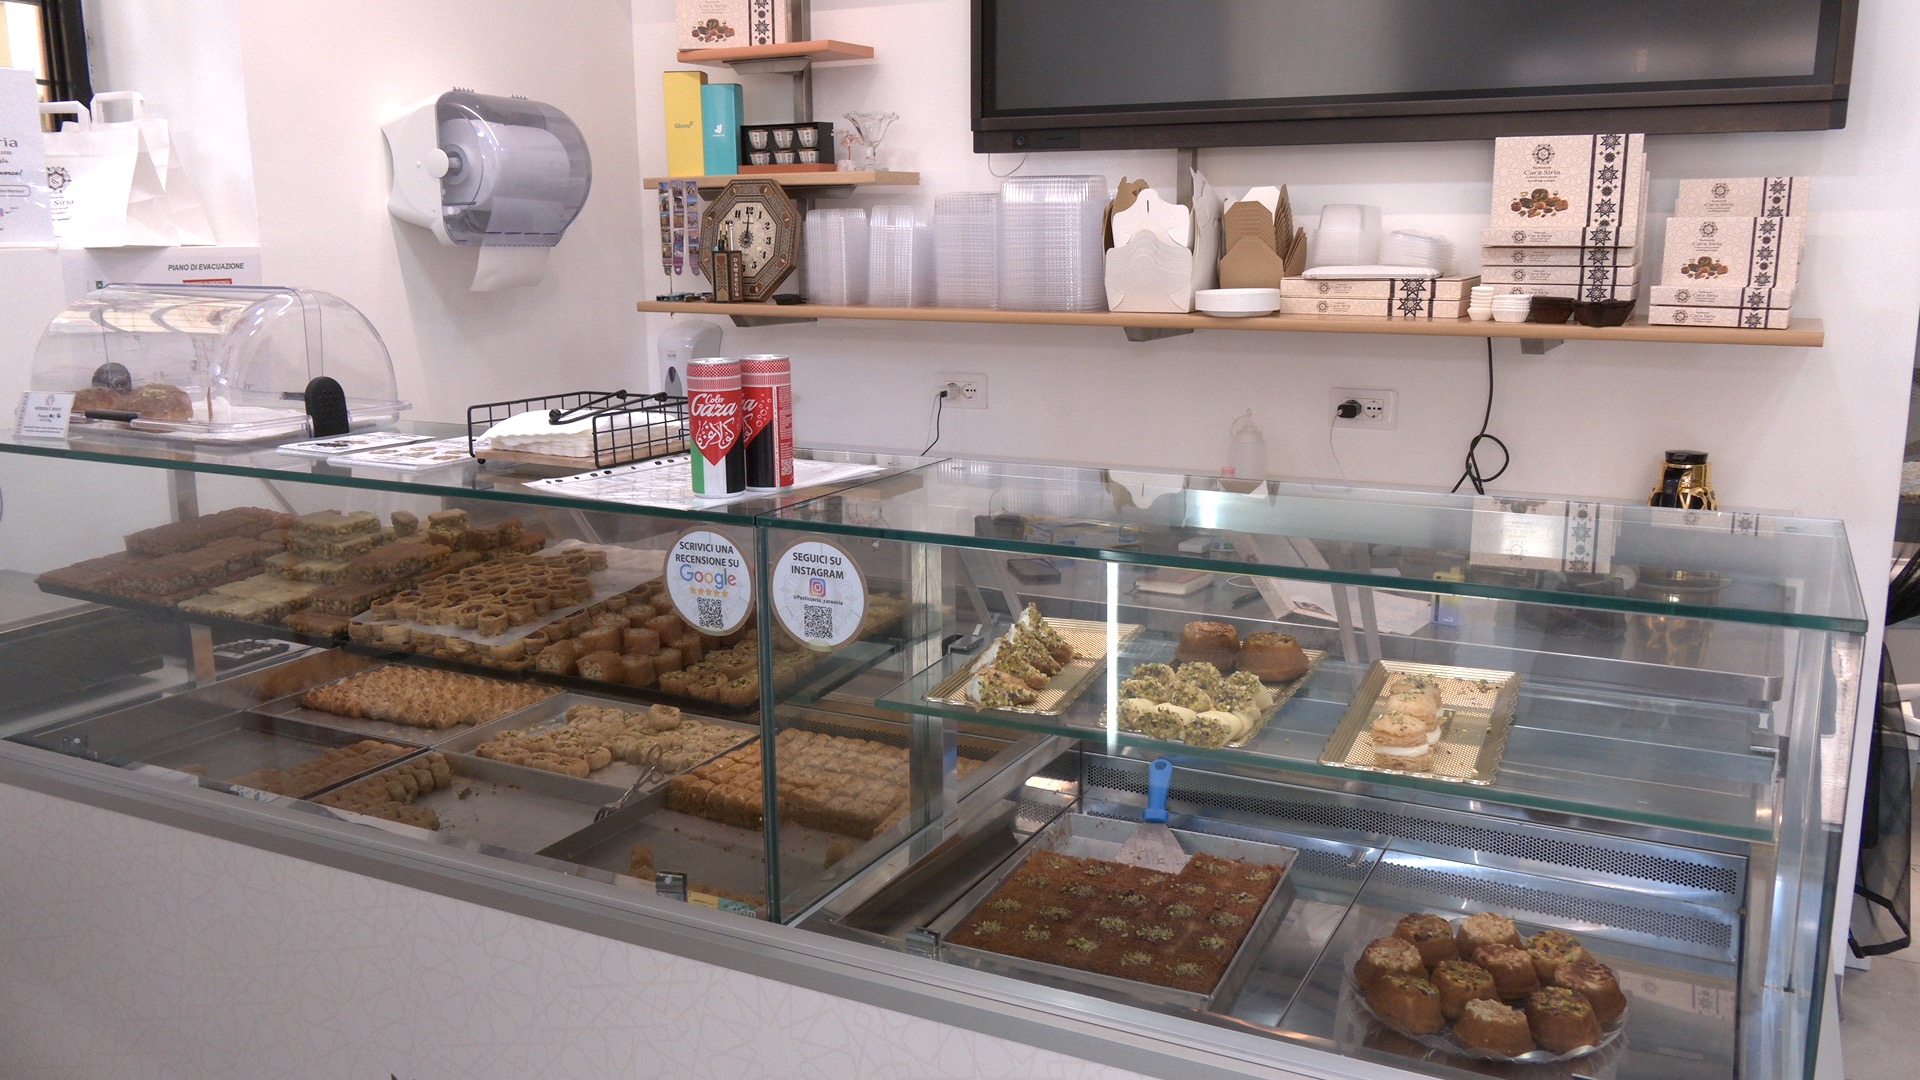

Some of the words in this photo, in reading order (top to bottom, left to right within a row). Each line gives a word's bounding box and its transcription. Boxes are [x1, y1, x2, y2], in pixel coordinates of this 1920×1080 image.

[0, 137, 18, 148] ia
[746, 206, 754, 215] 12
[765, 221, 771, 230] 2
[766, 236, 772, 245] 3
[167, 263, 189, 271] PIANO
[198, 262, 244, 271] EVACUAZIONE
[691, 393, 738, 417] Gaza
[705, 394, 724, 404] Cola
[679, 541, 714, 553] SCRIVICI
[715, 545, 734, 554] UNA
[675, 553, 727, 567] RECENSIONE
[728, 559, 740, 568] SU
[792, 552, 828, 564] SEGUICI
[829, 556, 842, 566] SU
[680, 563, 737, 590] Google
[791, 565, 844, 580] INSTAGRAM
